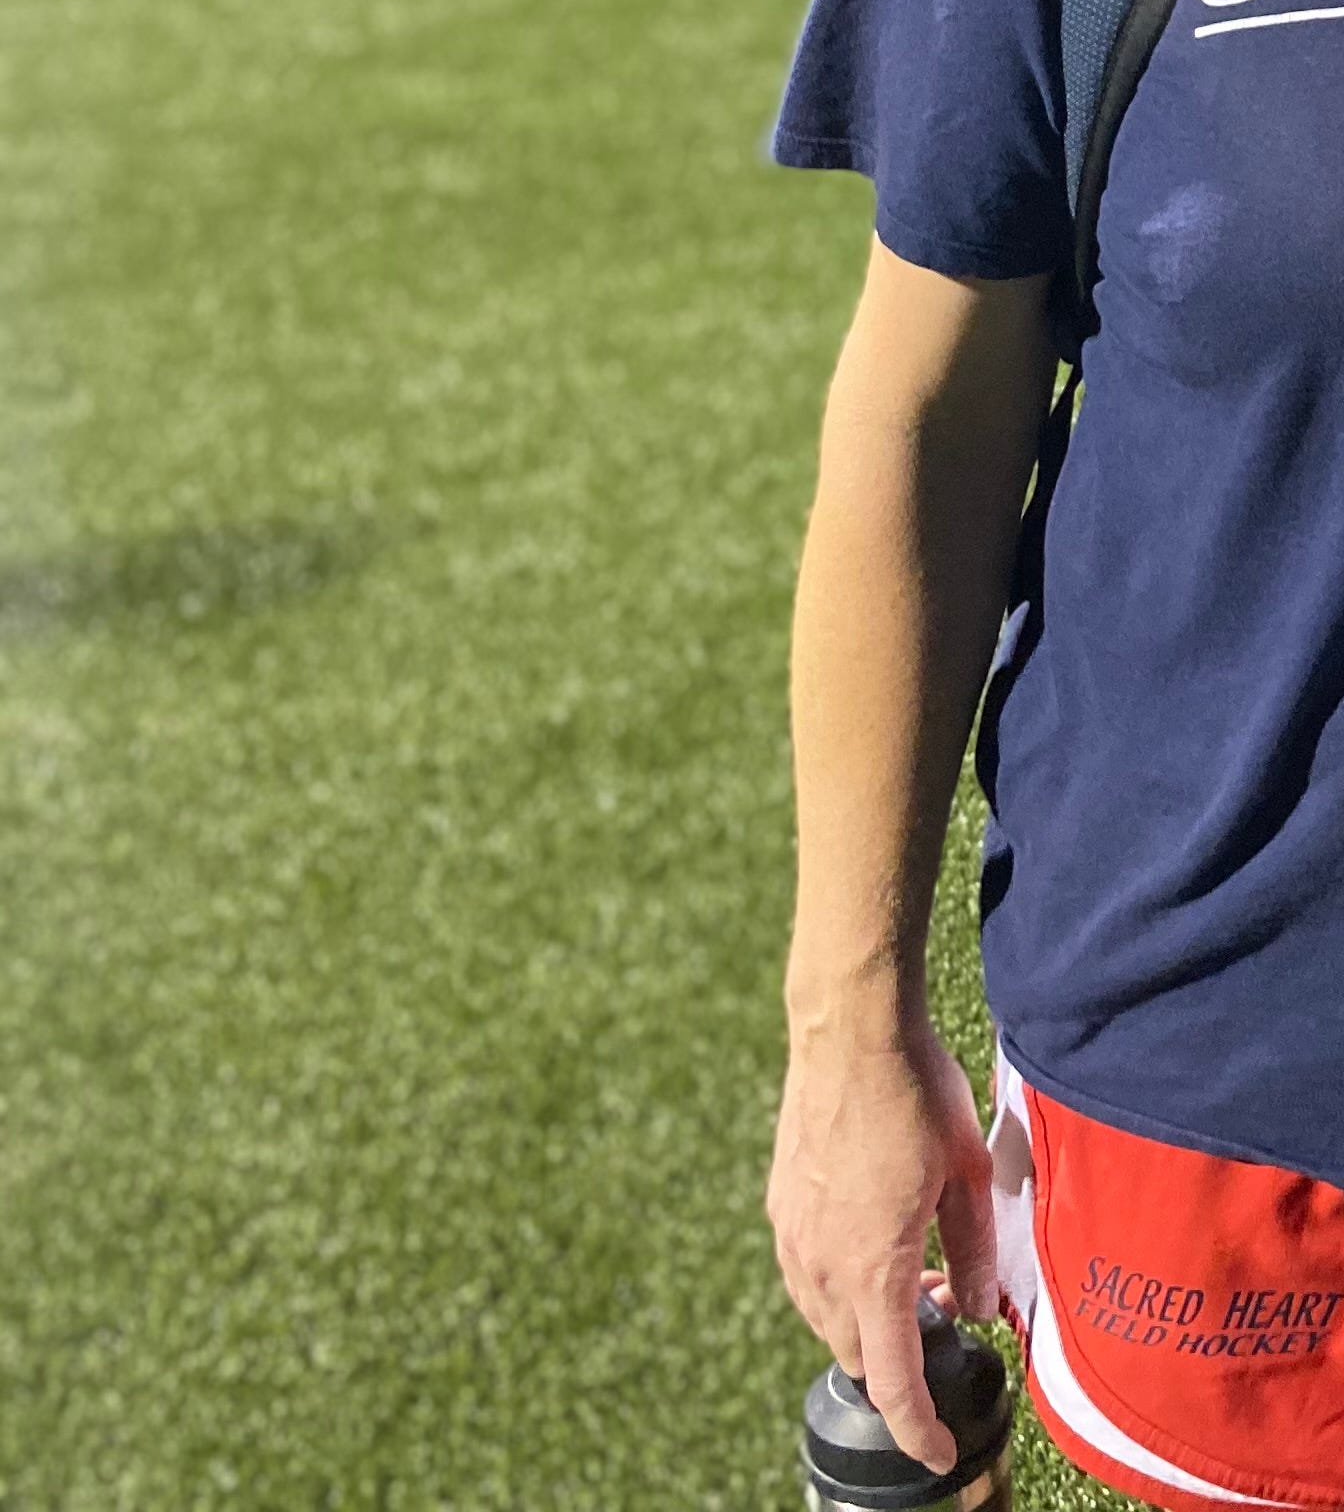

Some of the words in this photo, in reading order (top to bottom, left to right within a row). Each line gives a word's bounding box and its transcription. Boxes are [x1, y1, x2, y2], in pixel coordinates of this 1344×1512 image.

[1080, 1255, 1205, 1327] SACRED
[1073, 1297, 1169, 1348] FIELD
[1175, 1330, 1329, 1357] HOCKEY
